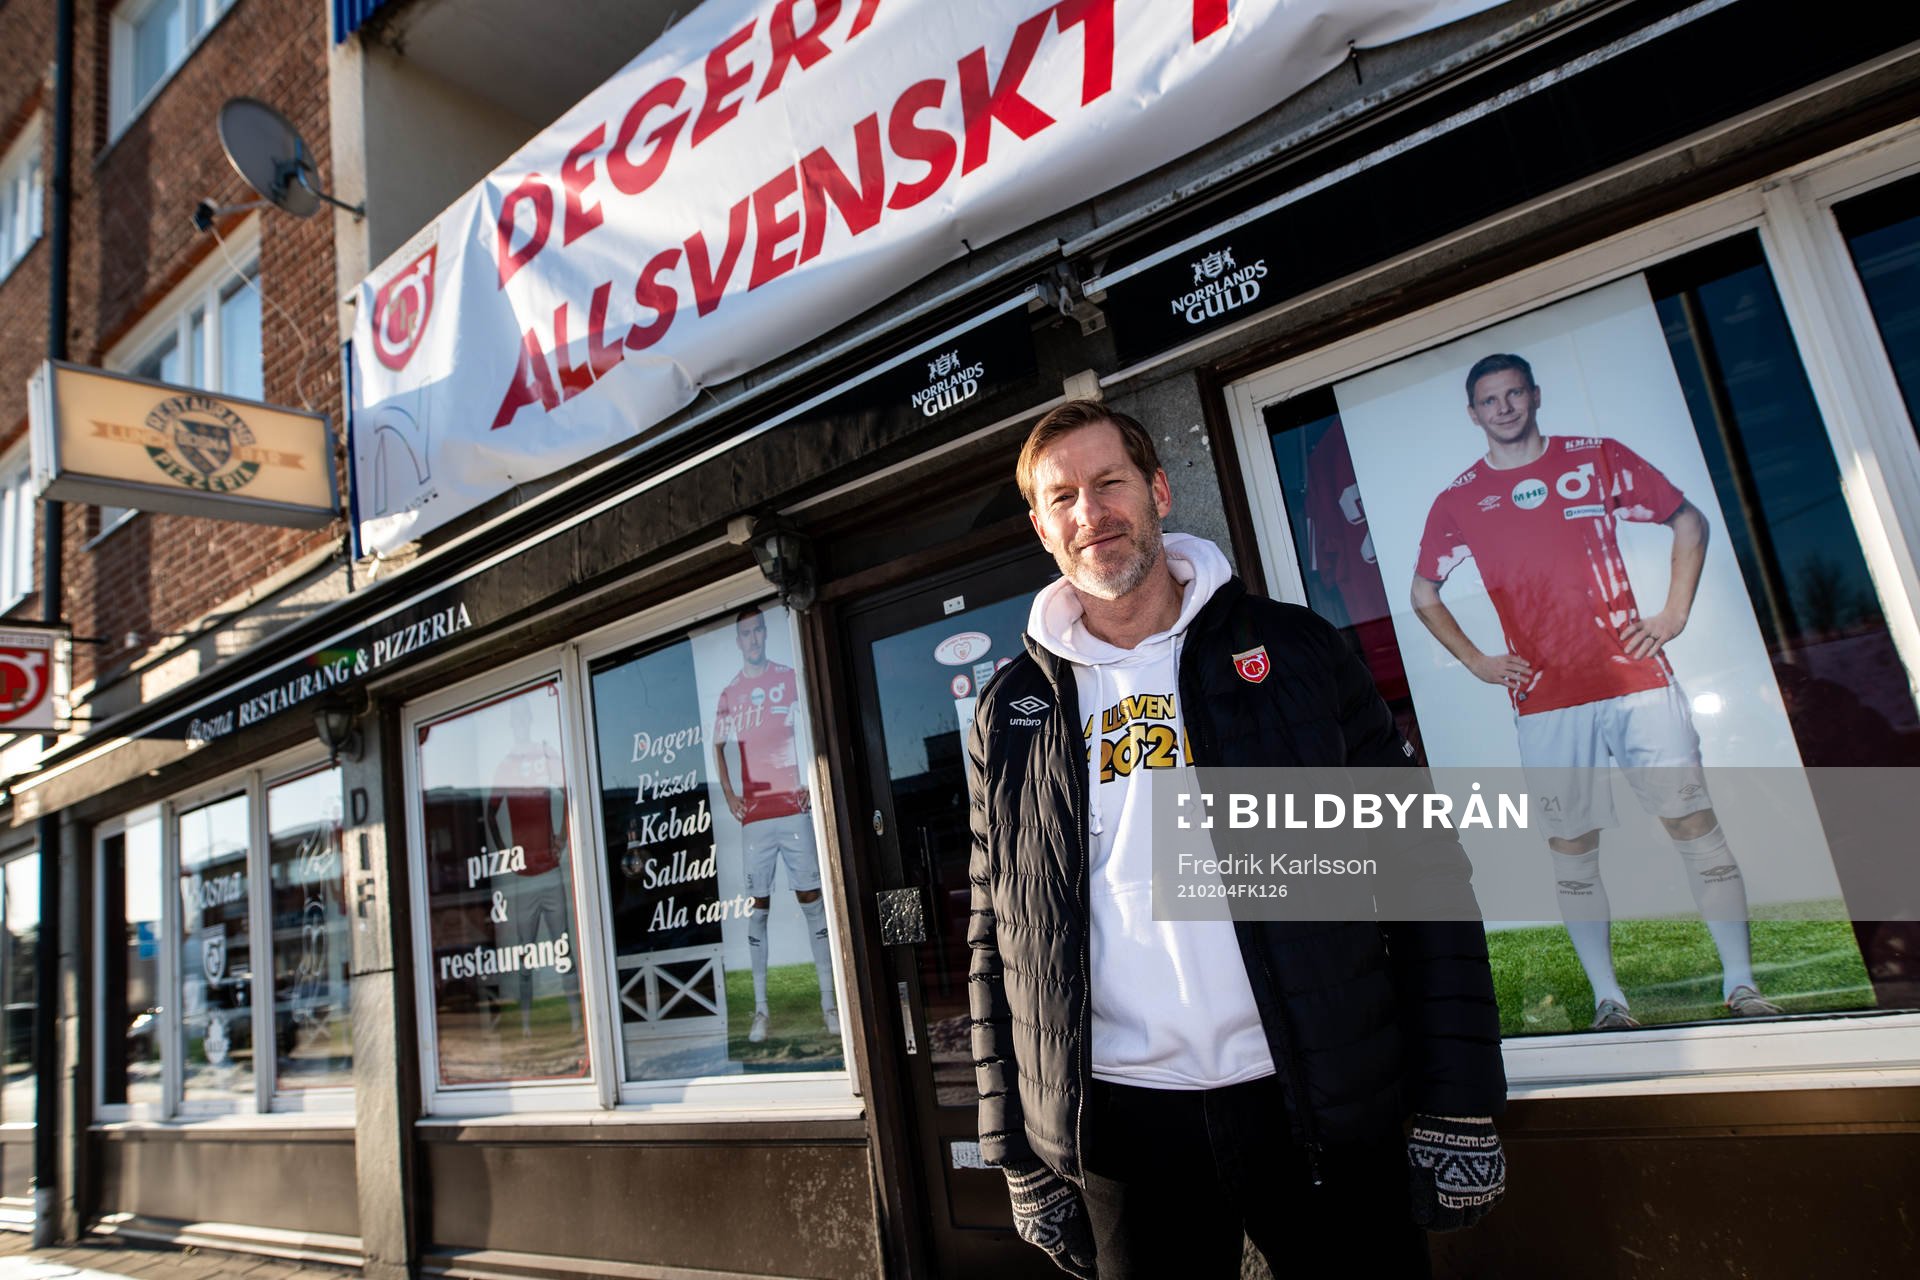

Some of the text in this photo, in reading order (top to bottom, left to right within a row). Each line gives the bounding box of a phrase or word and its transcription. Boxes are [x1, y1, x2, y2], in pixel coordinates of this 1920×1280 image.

[491, 0, 1115, 430] ALLSVENSKT
[1171, 259, 1269, 315] NORRLANDS
[1185, 279, 1261, 324] GULD
[911, 362, 985, 408] NORRLANDS
[922, 378, 978, 417] GULD
[152, 452, 254, 492] PIZZERIA
[1513, 487, 1546, 502] MHE
[239, 656, 349, 728] RESTAURANG
[353, 648, 369, 676] &
[372, 602, 472, 669] PIZZERIA
[1009, 717, 1042, 727] umbro
[1086, 722, 1195, 784] 2021
[635, 769, 698, 804] Pizza
[1540, 795, 1561, 812] 21
[639, 800, 711, 846] Kebab
[467, 845, 527, 888] pizza
[643, 844, 717, 889] Sallad
[490, 890, 508, 923] &
[648, 893, 756, 932] Ala carte
[441, 932, 572, 980] restaurang
